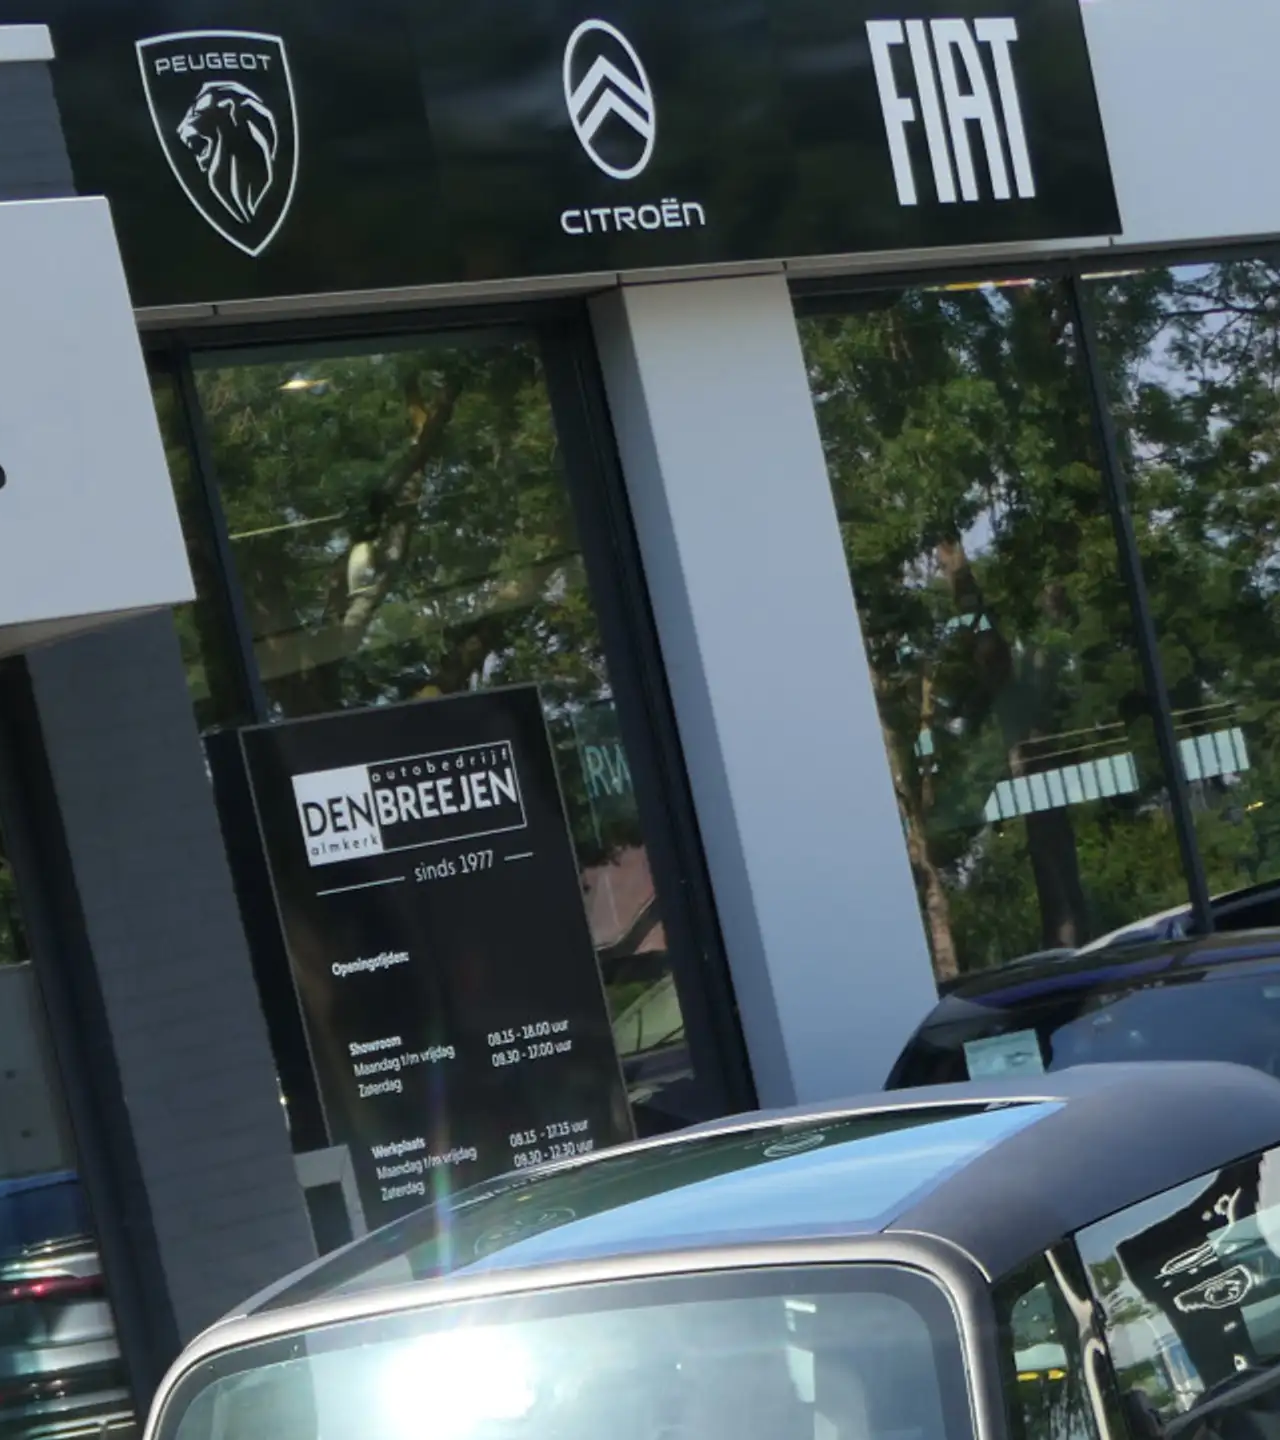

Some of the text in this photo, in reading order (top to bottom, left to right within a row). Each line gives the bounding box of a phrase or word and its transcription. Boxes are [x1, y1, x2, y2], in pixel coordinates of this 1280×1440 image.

[153, 51, 273, 77] PEUGEOT
[865, 17, 1037, 206] FIAT
[372, 747, 509, 783] autobedrijf
[301, 767, 519, 838] DEN BREEJEN
[310, 835, 380, 857] almkerk
[415, 849, 494, 882] sinds 1977
[348, 1035, 403, 1057] Showroom
[353, 1056, 402, 1077] Maandag
[420, 1045, 457, 1064] vrijdag
[521, 1021, 551, 1040] 18.00
[551, 1019, 569, 1034] uur
[357, 1078, 404, 1099] Zaterdag
[376, 1159, 423, 1180] Maandag
[381, 1181, 425, 1201] Zaterdag
